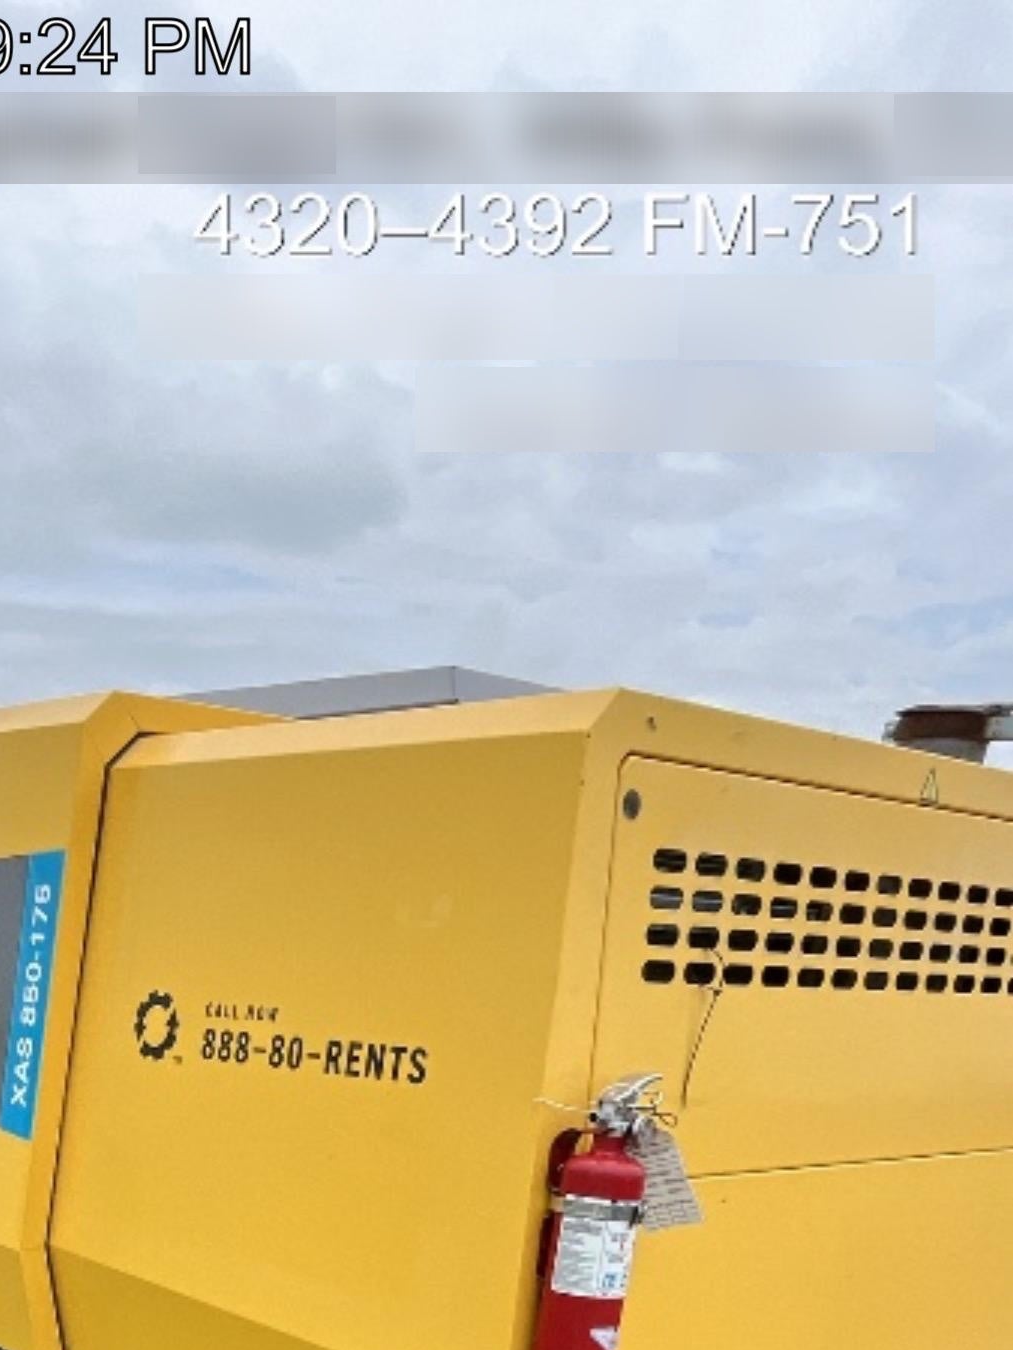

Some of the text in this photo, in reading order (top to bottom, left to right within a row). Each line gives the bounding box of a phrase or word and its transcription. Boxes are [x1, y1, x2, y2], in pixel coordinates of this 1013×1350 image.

[204, 1001, 279, 1023] CALL NOW
[10, 1036, 34, 1108] XAS
[200, 1028, 428, 1085] 888-80-RENTS
